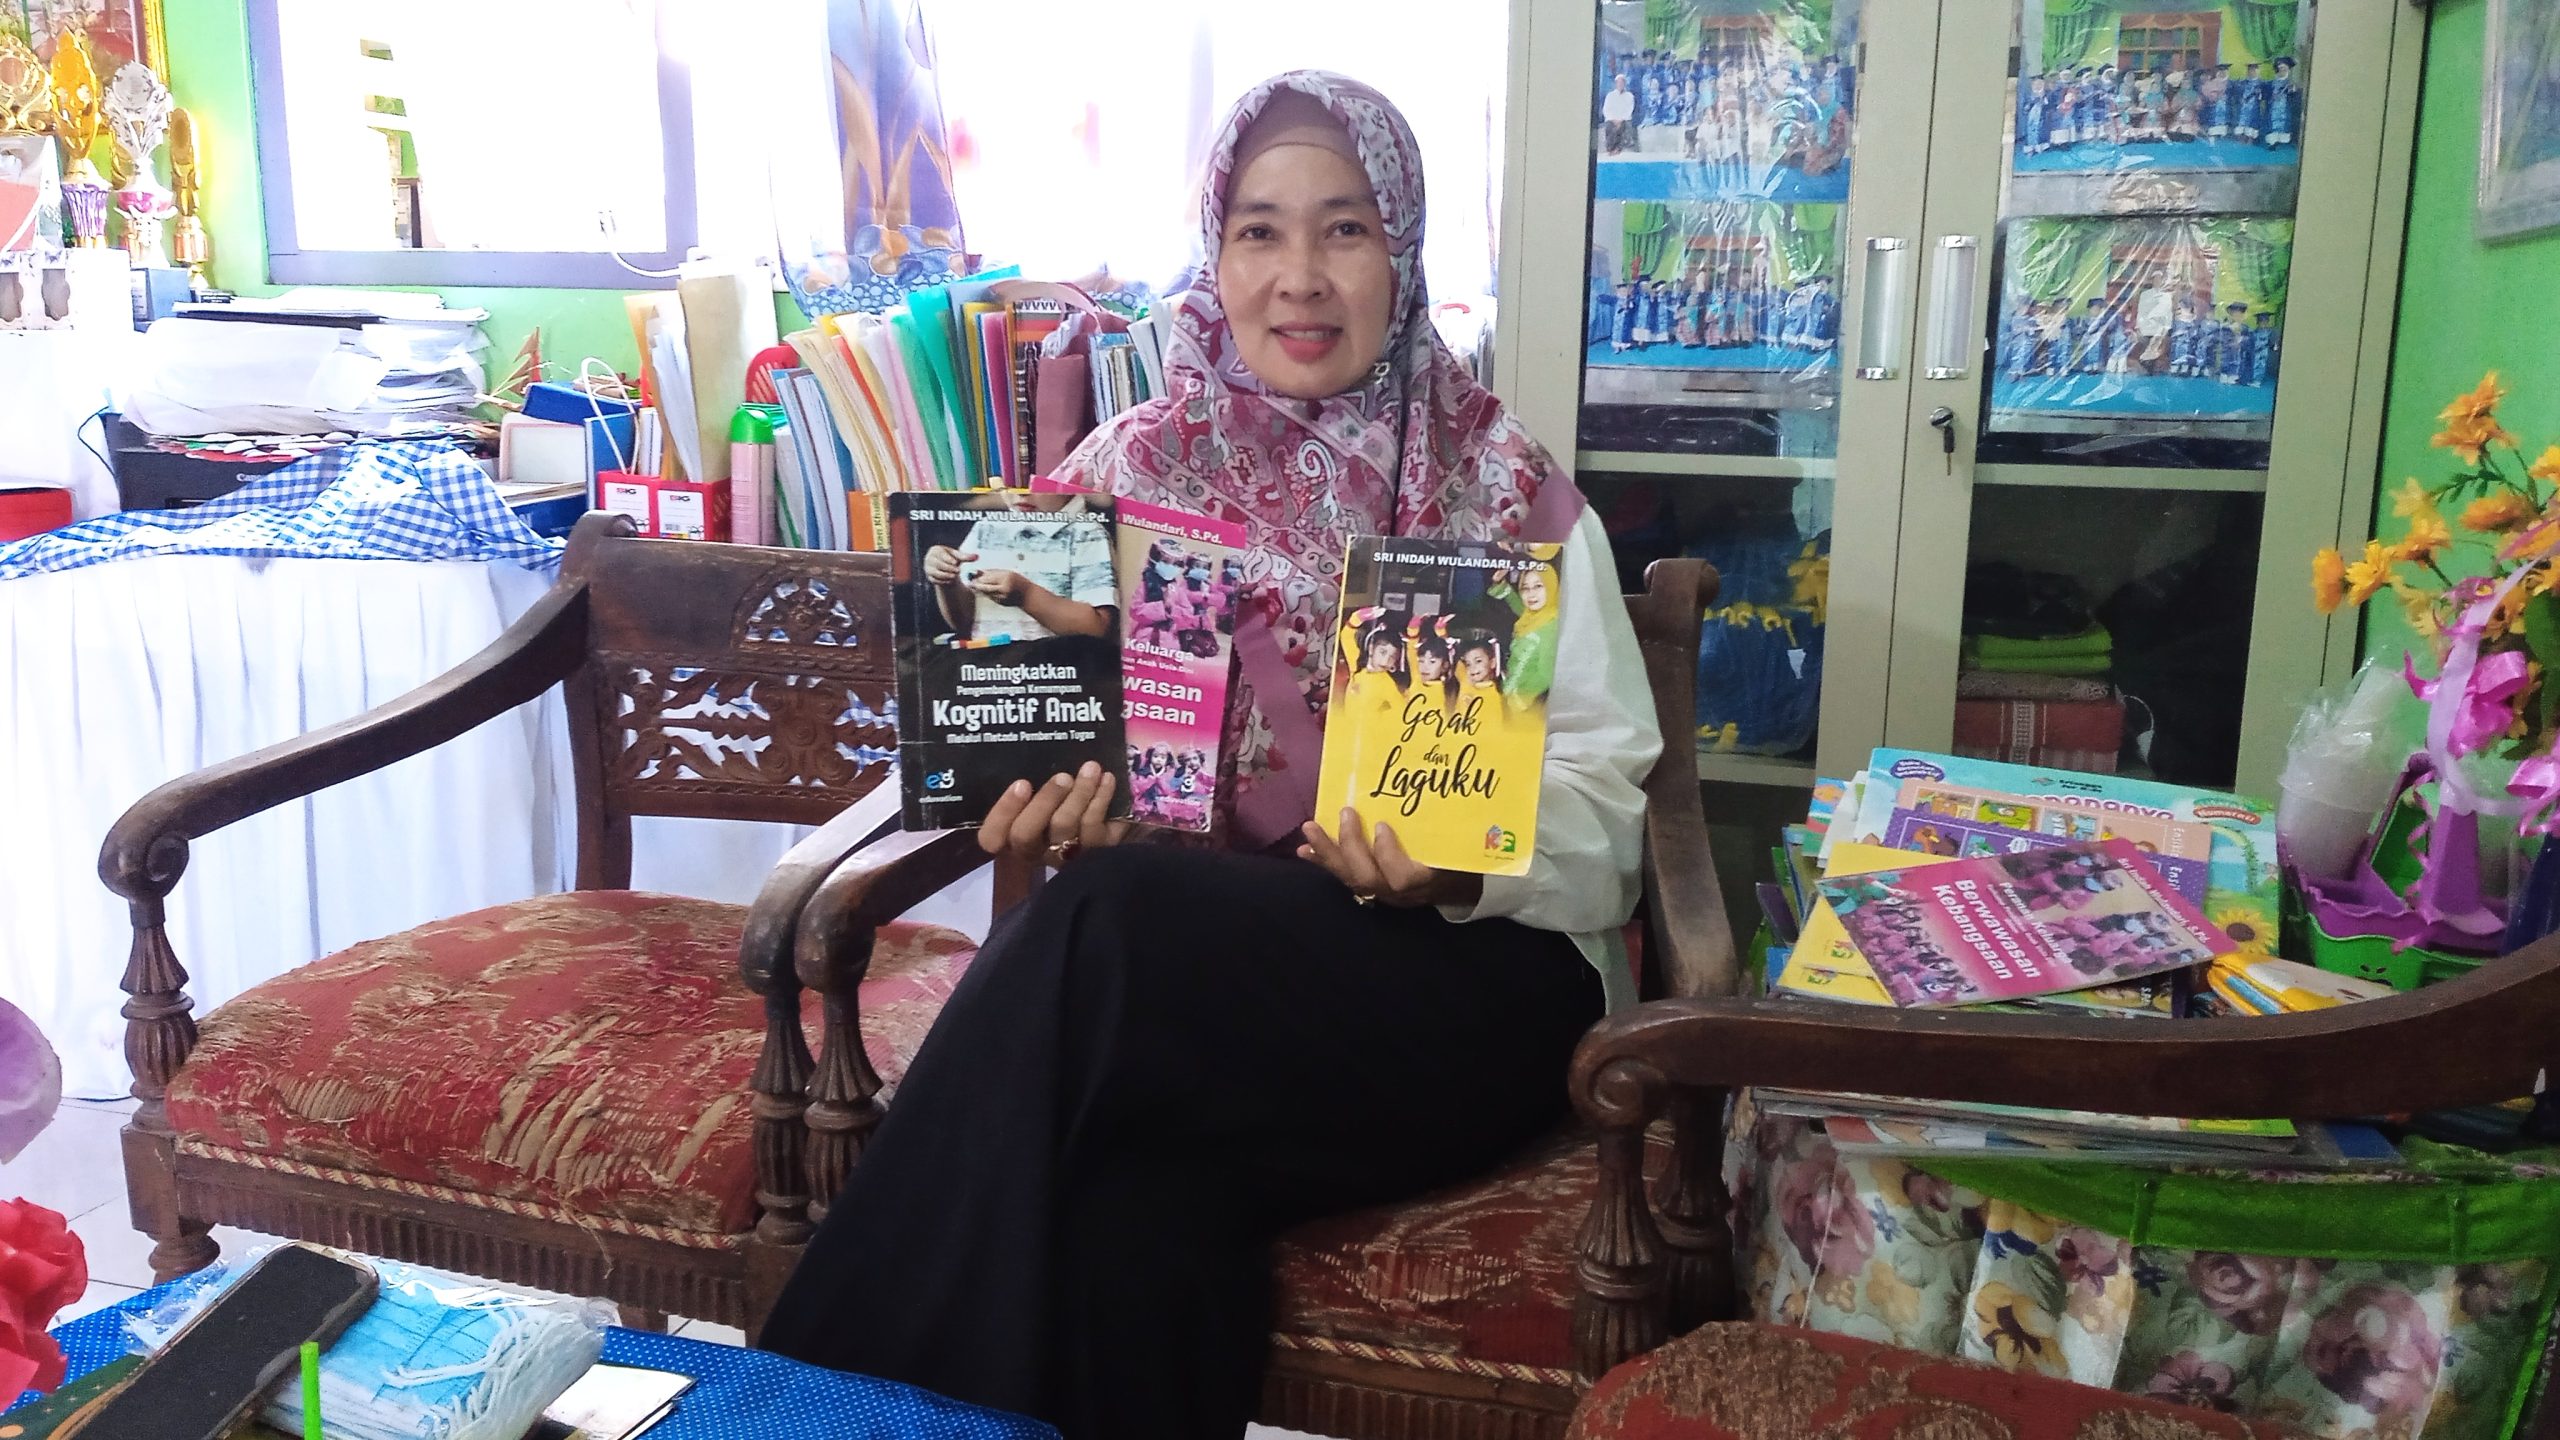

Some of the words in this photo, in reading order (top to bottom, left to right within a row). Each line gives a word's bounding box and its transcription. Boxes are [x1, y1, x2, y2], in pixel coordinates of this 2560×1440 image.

[909, 509, 934, 522] SRI
[937, 509, 984, 522] INDAH
[1076, 511, 1111, 524] S.Pd.
[1122, 512, 1189, 538] Wulandari,
[1190, 528, 1223, 545] S.Pd.
[1373, 551, 1394, 563] SRI
[1396, 552, 1436, 566] INDAH
[1437, 555, 1515, 572] WULANDARI,
[1516, 559, 1549, 573] S.Pd.
[1124, 637, 1195, 663] Keluarga
[960, 662, 1078, 685] Meningkatkan
[932, 697, 1040, 732] Kognitif
[1045, 696, 1107, 723] Anak
[1400, 692, 1484, 743] Gerak
[1423, 743, 1450, 767] dan
[1369, 743, 1501, 818] Laguku
[1999, 881, 2036, 922] Peranan
[1931, 883, 2014, 981] Kebangsaan
[1954, 878, 2042, 979] Berwawasan
